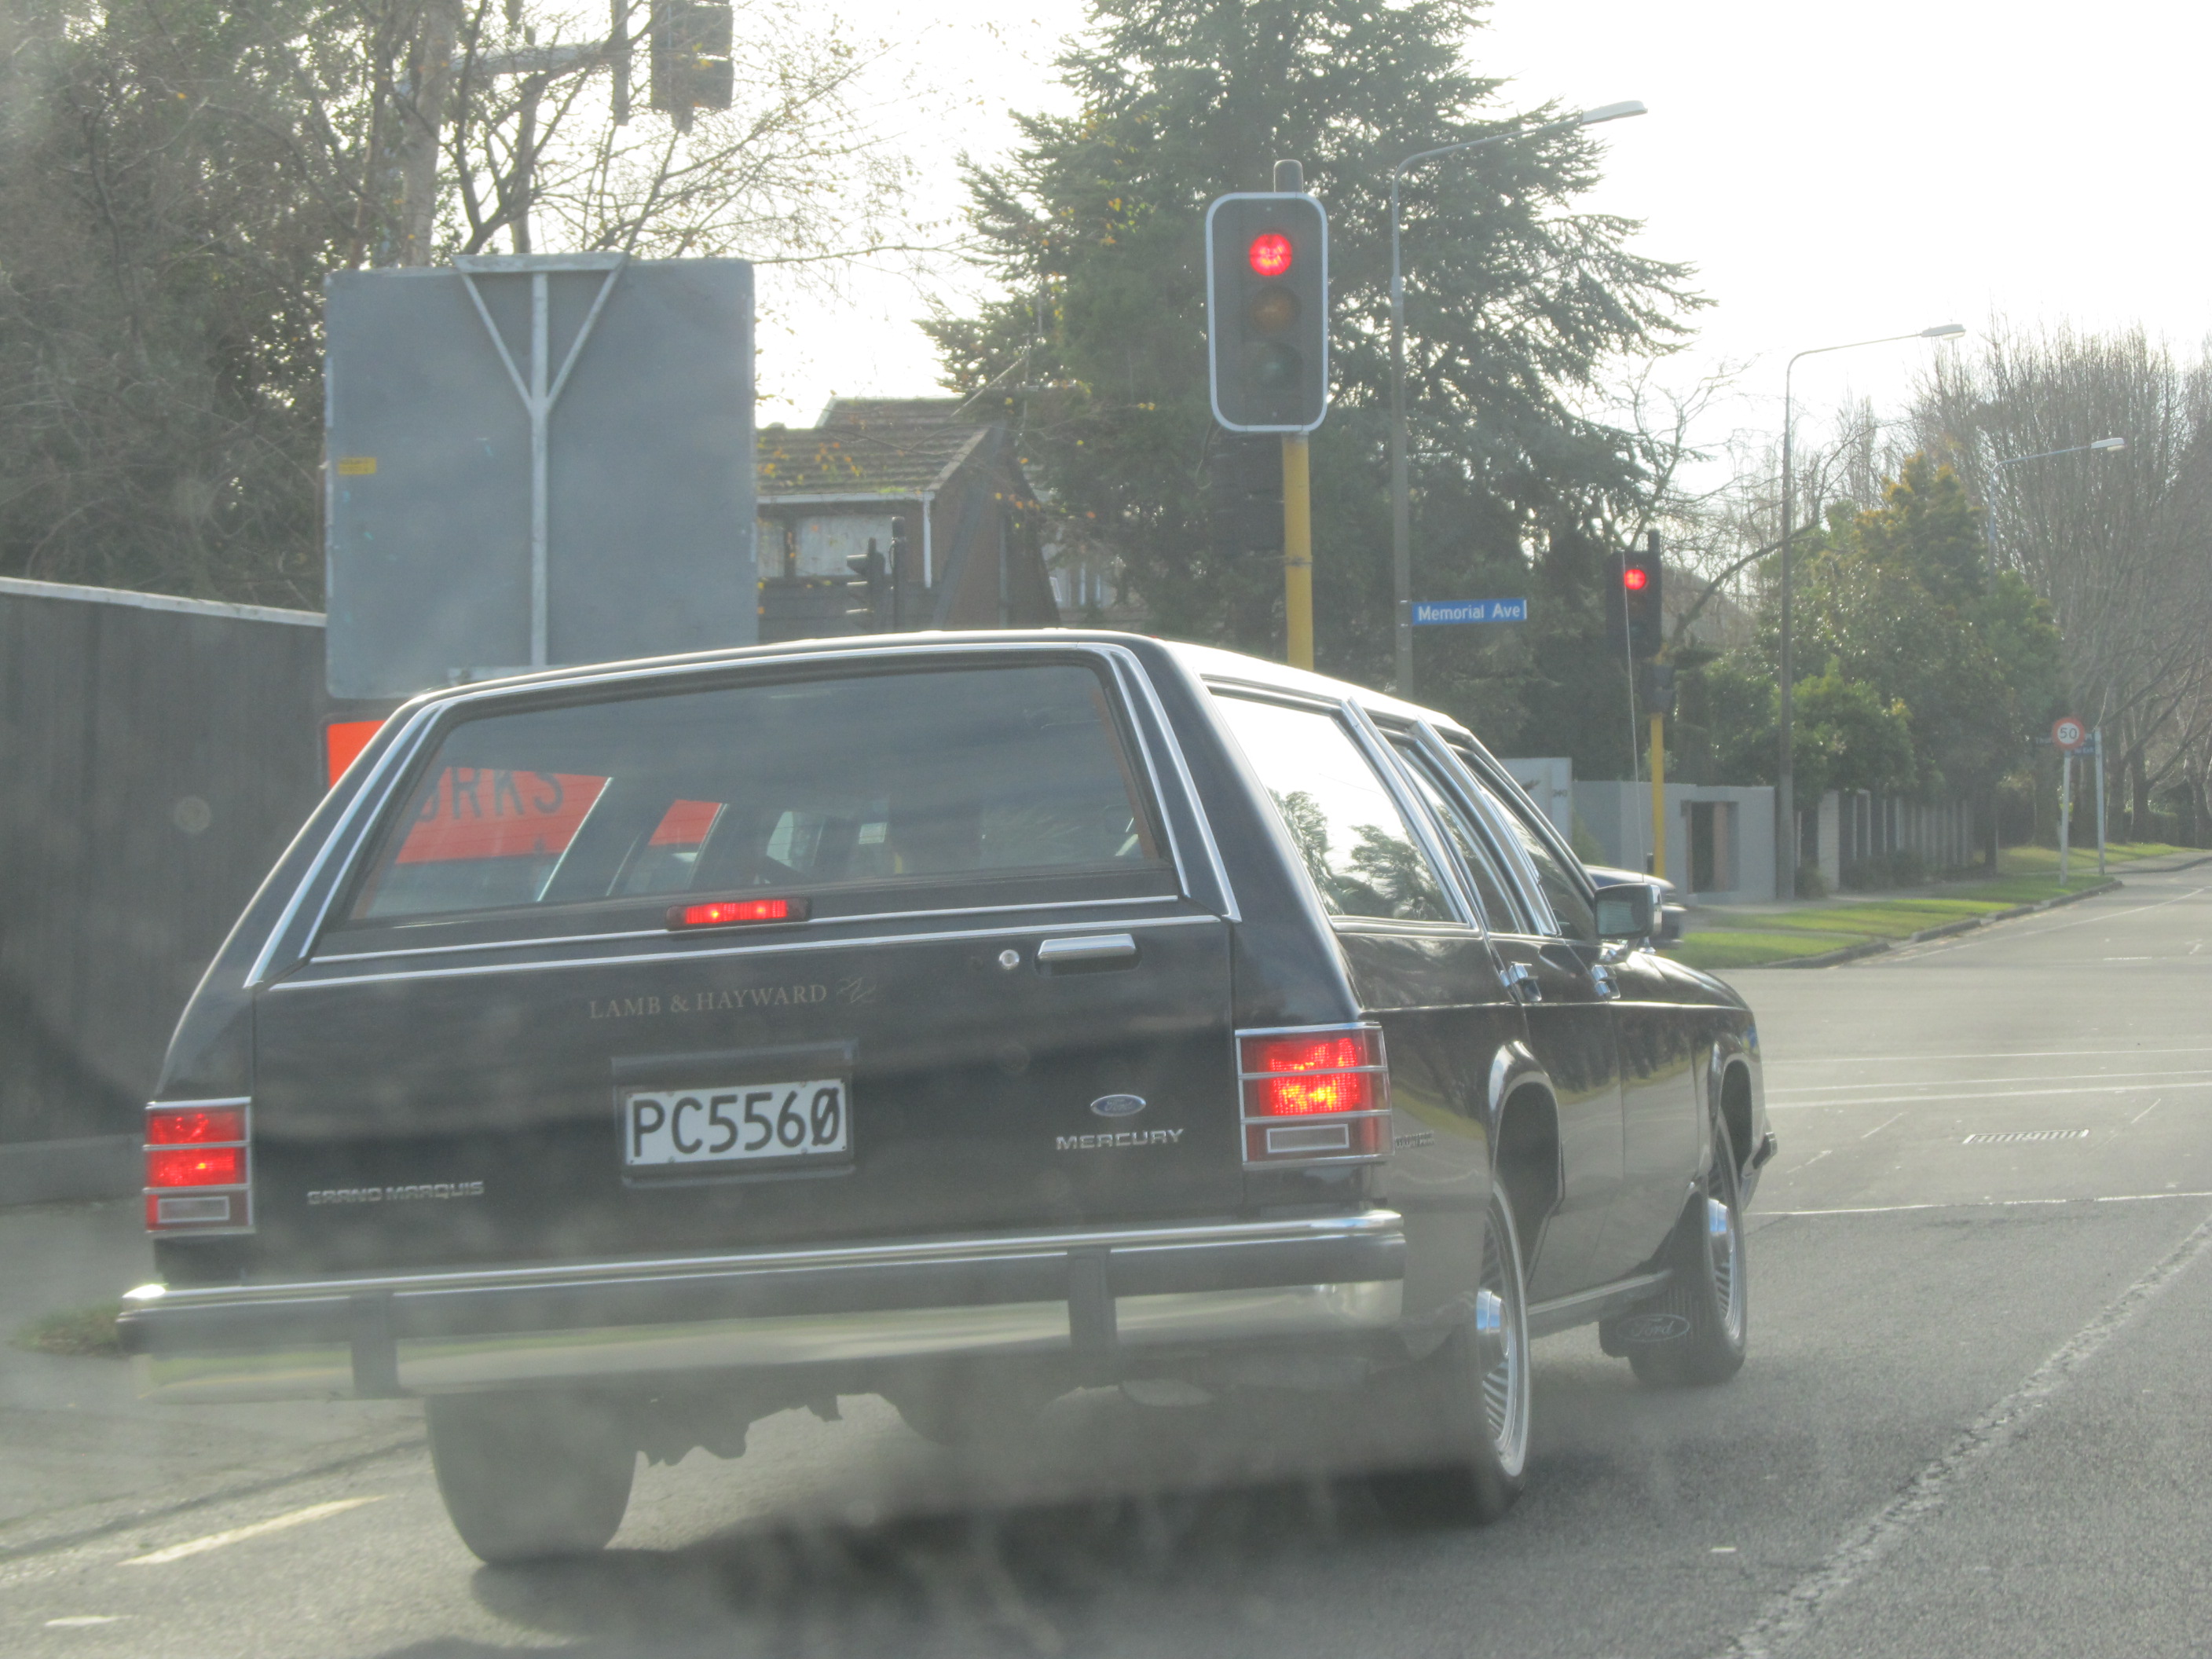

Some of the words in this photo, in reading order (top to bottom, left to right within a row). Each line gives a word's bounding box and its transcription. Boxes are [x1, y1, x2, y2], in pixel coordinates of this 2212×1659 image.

[1418, 604, 1485, 621] Memorial
[1492, 602, 1521, 618] Ave
[2060, 727, 2078, 739] 50
[589, 995, 661, 1019] LAMB
[670, 994, 690, 1013] &
[696, 983, 828, 1012] HAYWARD
[632, 1086, 840, 1158] PC5560
[1056, 1128, 1184, 1151] MERCURY
[307, 1186, 382, 1205] GRAND
[385, 1181, 485, 1201] MARQUIS
